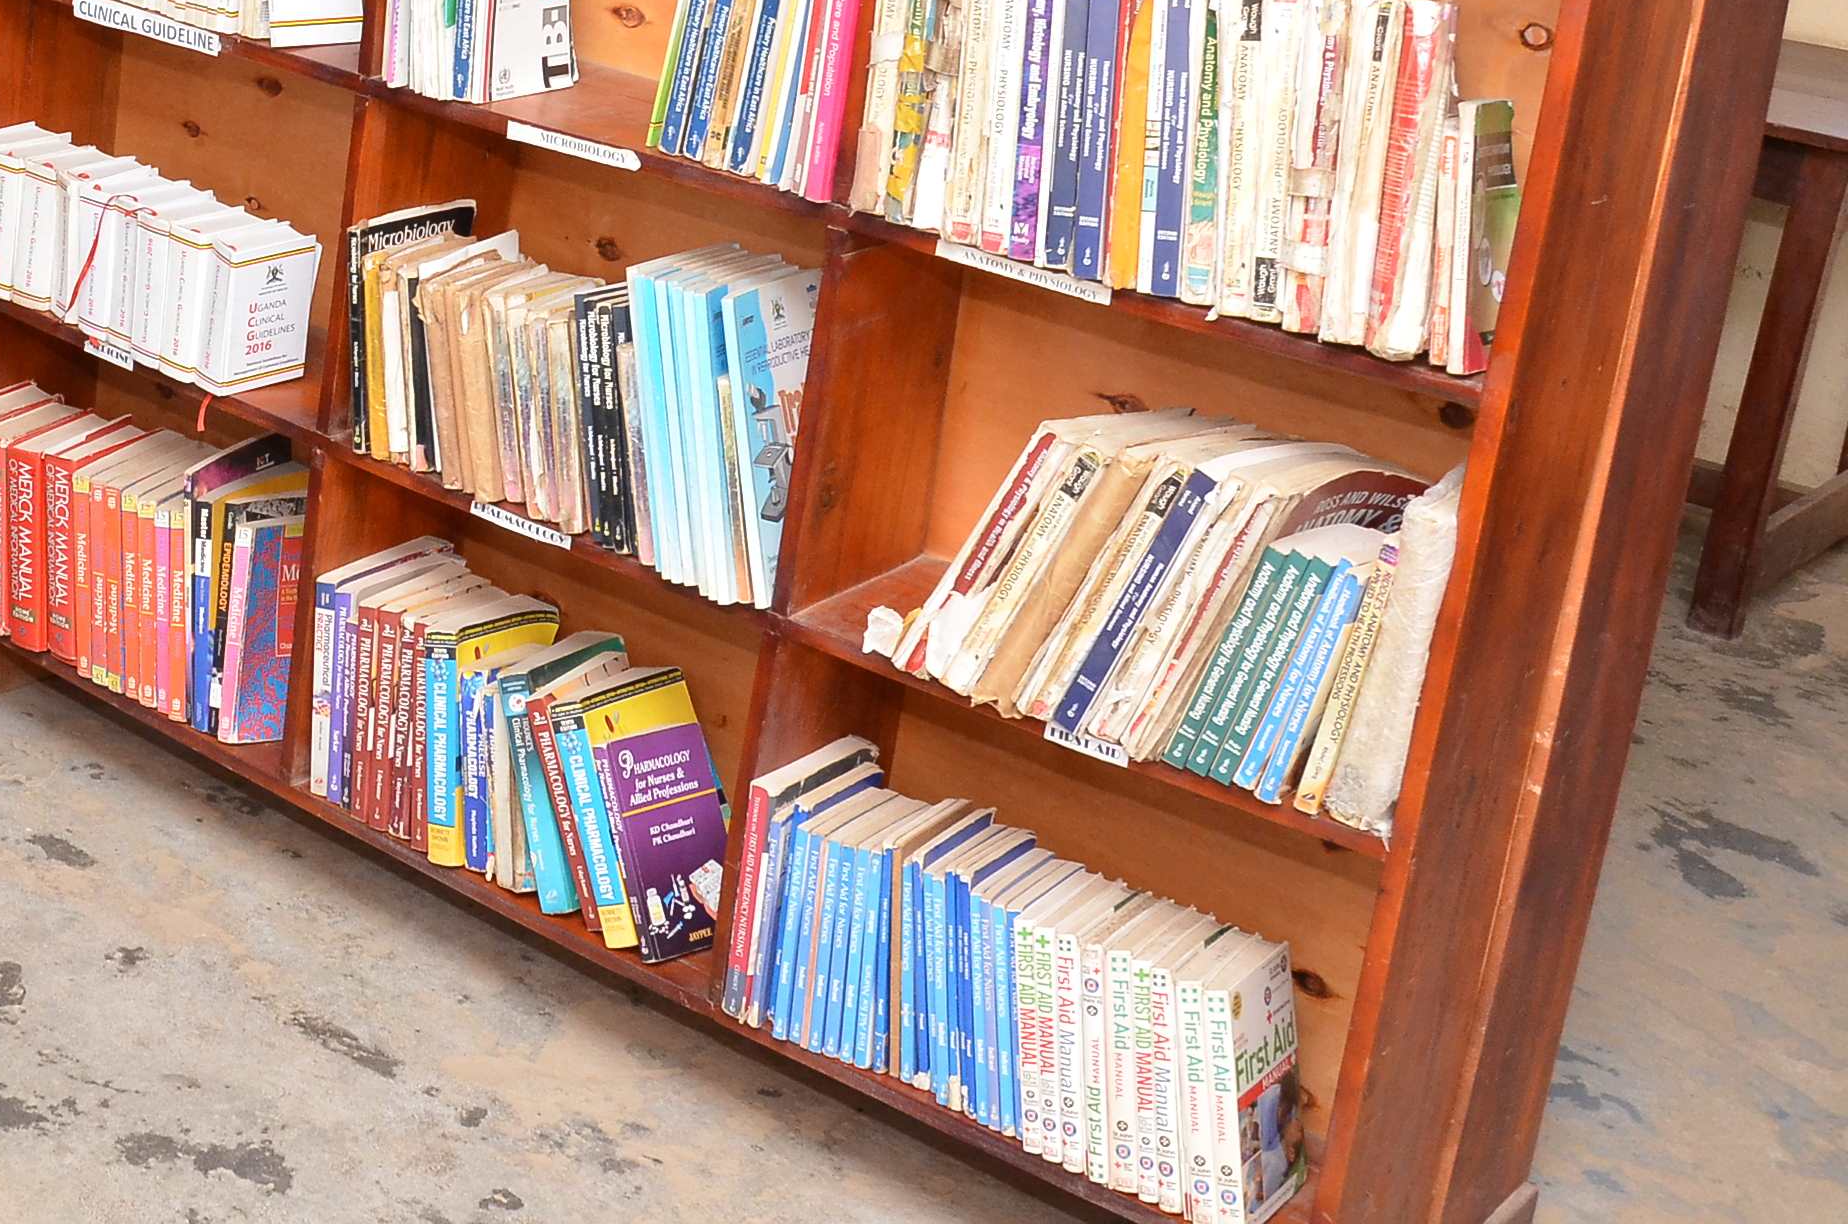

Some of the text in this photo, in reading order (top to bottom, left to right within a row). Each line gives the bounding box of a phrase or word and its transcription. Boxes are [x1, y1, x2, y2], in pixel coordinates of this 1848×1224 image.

[78, 0, 214, 52] CLINICAL GUIDELINE
[831, 23, 840, 40] and
[823, 44, 839, 97] Population
[539, 131, 626, 165] MICROBIOLOGY
[367, 217, 456, 252] Microbiology
[963, 250, 1098, 300] ANATOMY & PHYSIOLOGY
[247, 314, 285, 328] CLINICAL
[249, 299, 287, 314] UGANDA
[245, 340, 272, 356] 2016
[246, 324, 296, 342] GUIDELINES
[18, 461, 33, 601] MERCK MANUAL
[173, 570, 184, 623] Medicine
[216, 541, 233, 612] EPIDEMIOLOGY
[229, 586, 243, 639] Medicine
[432, 681, 448, 823] CLINICAL PHARMACOLOGY
[618, 749, 691, 779] PHARMACOLOGY
[630, 781, 699, 807] Allied Professions
[635, 767, 685, 793] for Nurses &
[1018, 943, 1037, 1067] FIRST AID MANUAL
[1058, 956, 1075, 1099] First Aid Manual
[1235, 1011, 1296, 1092] First Aid
